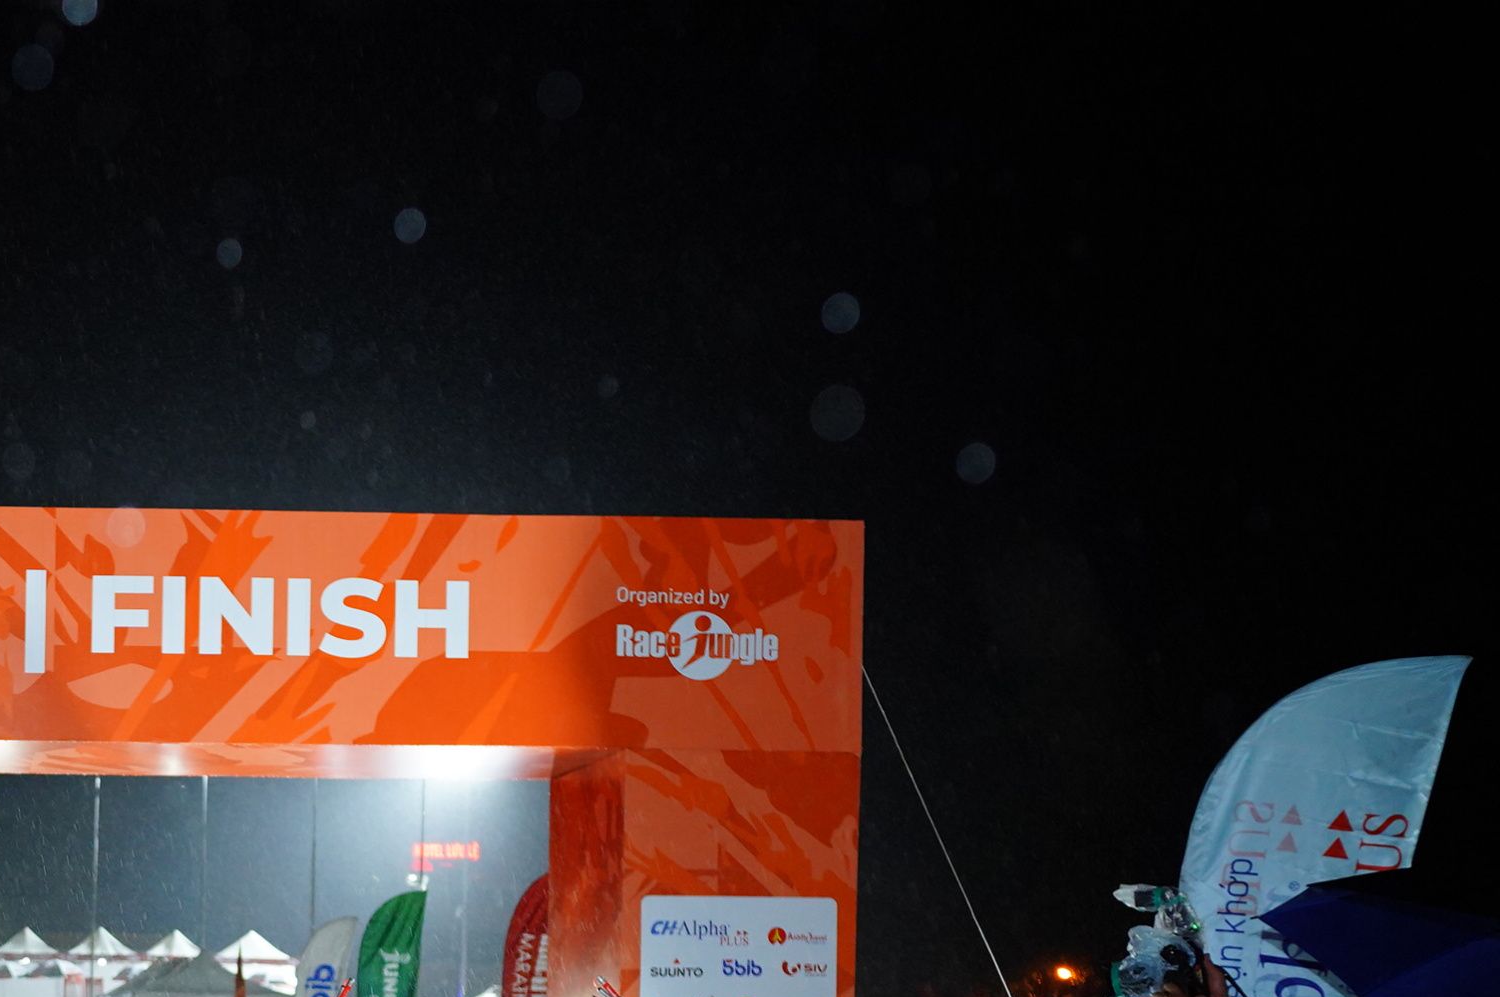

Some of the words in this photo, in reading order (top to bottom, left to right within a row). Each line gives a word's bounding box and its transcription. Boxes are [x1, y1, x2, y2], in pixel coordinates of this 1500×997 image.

[616, 586, 704, 607] Organized
[709, 589, 729, 609] by
[91, 575, 470, 659] FINISH
[719, 935, 749, 947] PLUS
[650, 967, 704, 978] SUUNTO
[722, 959, 763, 977] 5bib
[804, 963, 828, 973] SIV
